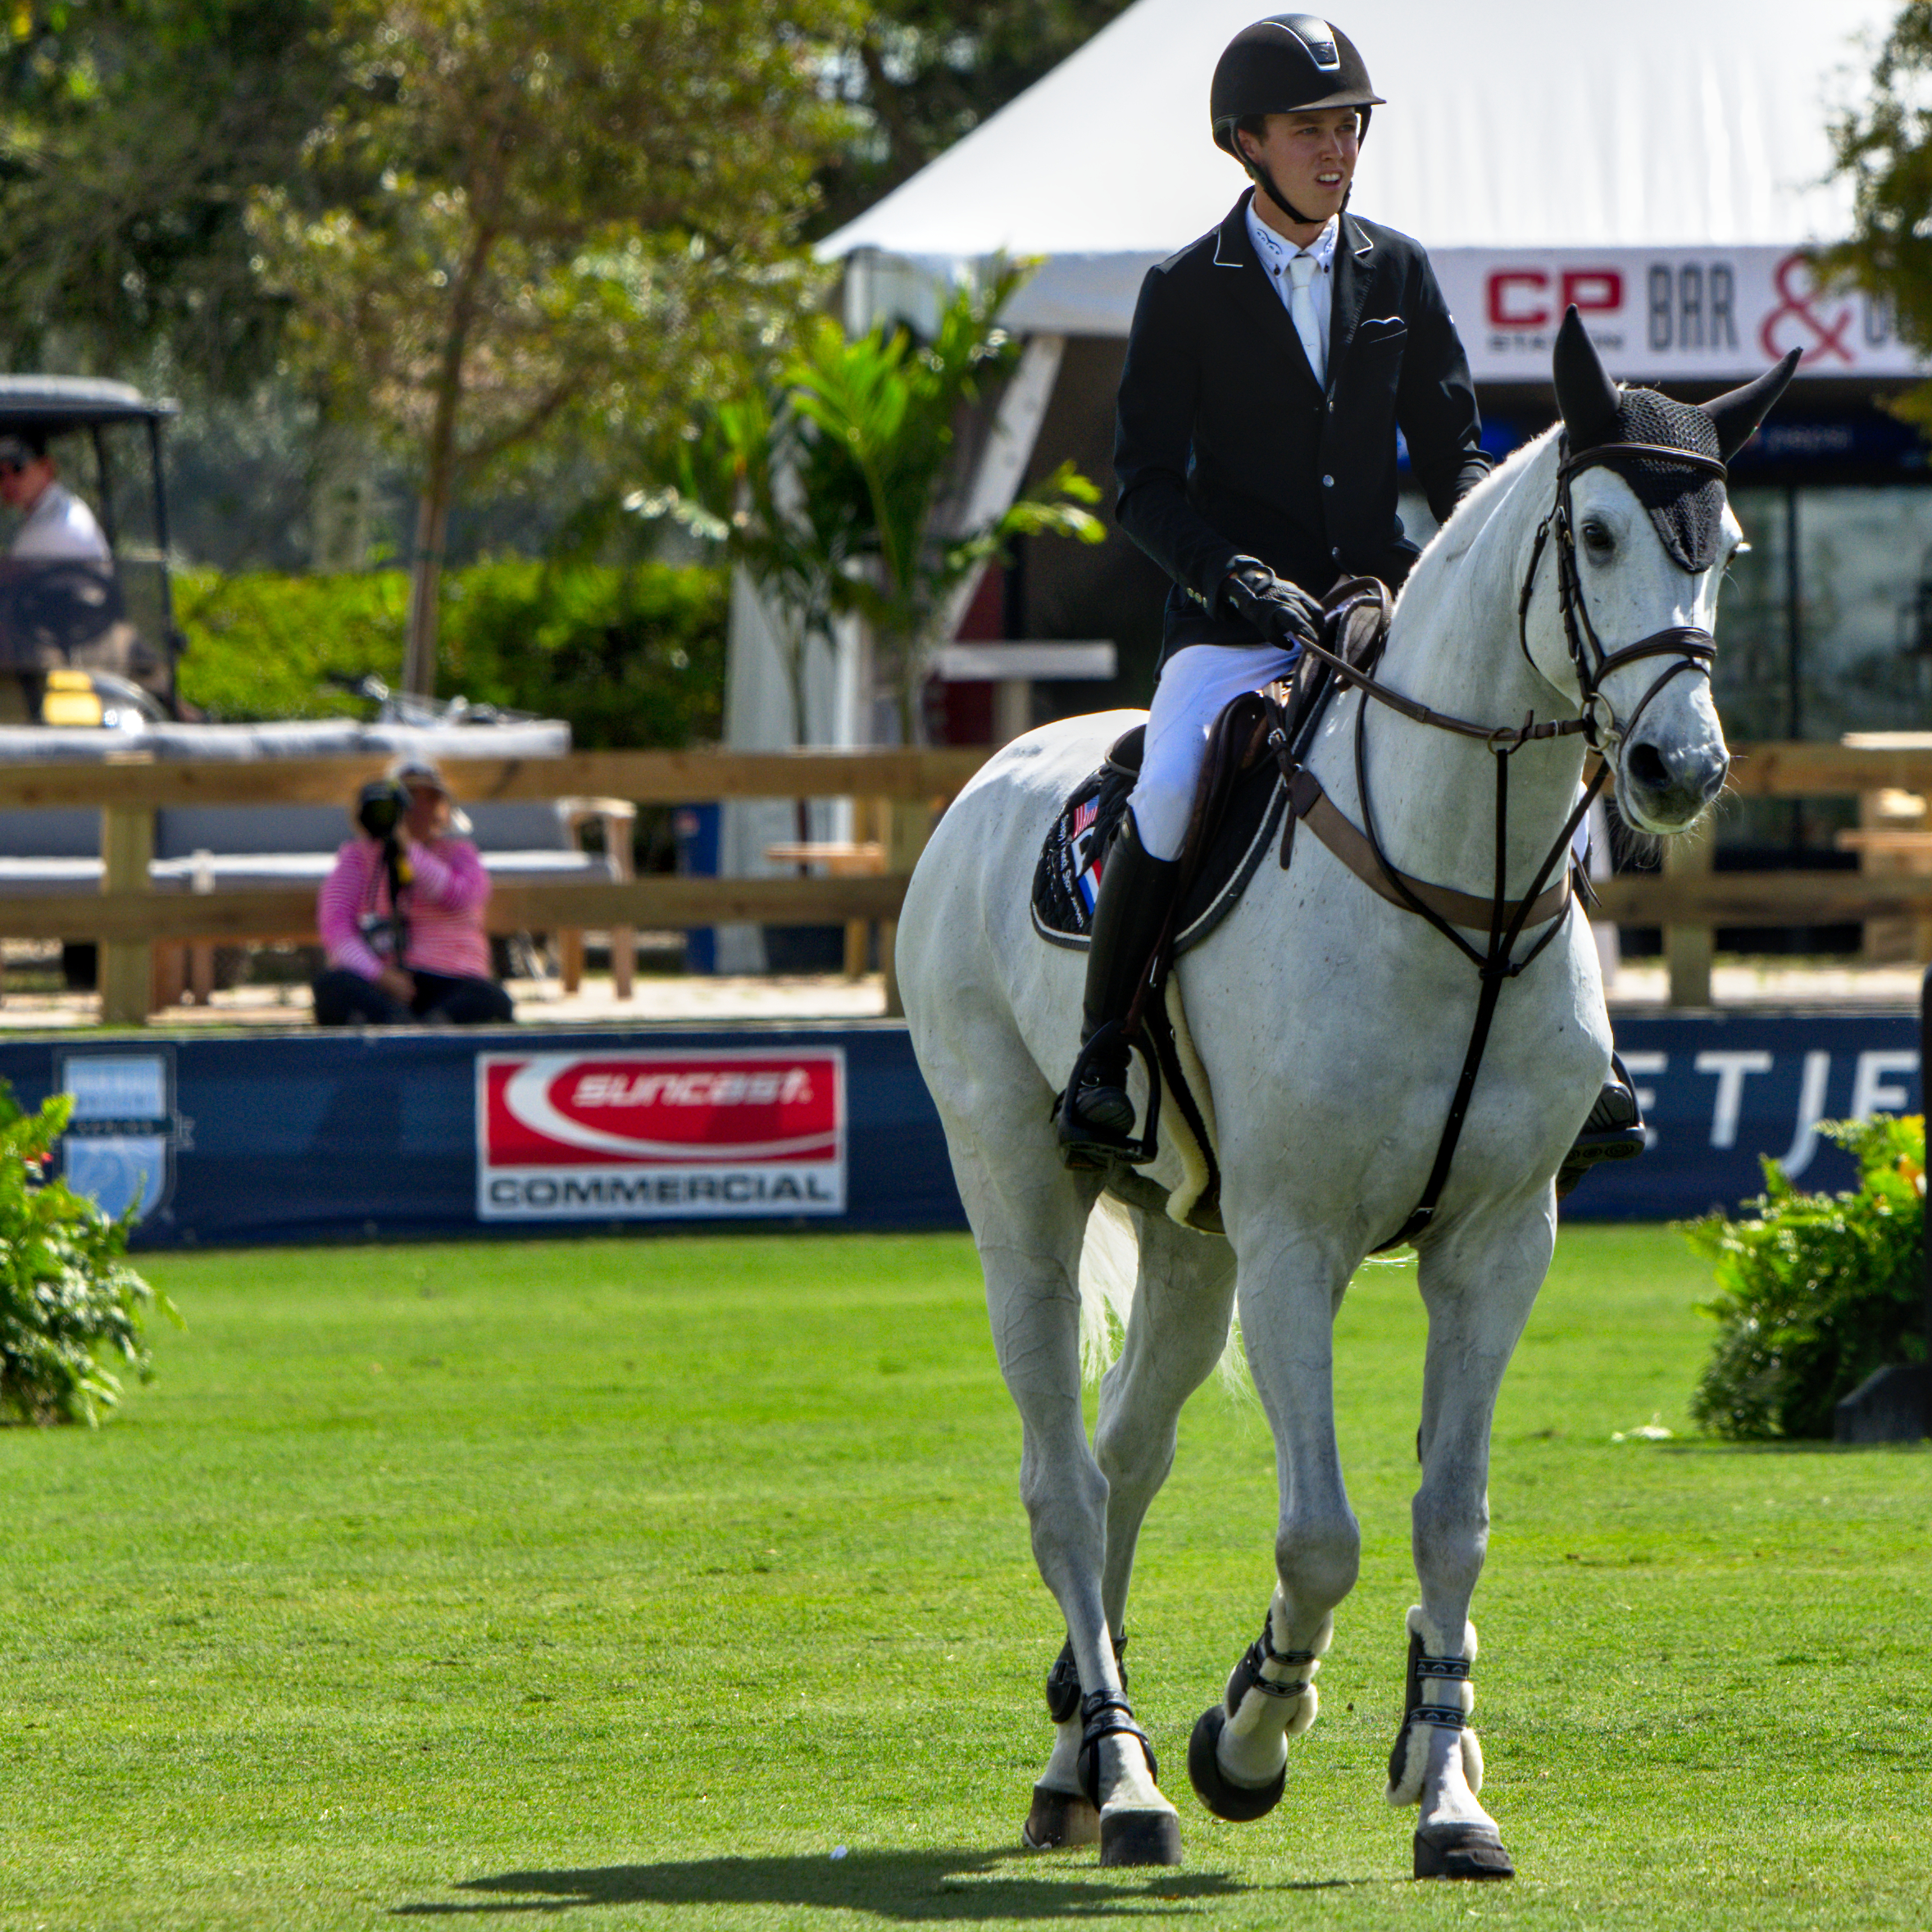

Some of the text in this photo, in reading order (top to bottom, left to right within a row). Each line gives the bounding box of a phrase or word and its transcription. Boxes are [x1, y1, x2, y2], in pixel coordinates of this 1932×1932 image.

[1484, 267, 1624, 326] CP
[1647, 261, 1739, 352] BAR
[490, 1174, 833, 1208] COMMERCIAL
